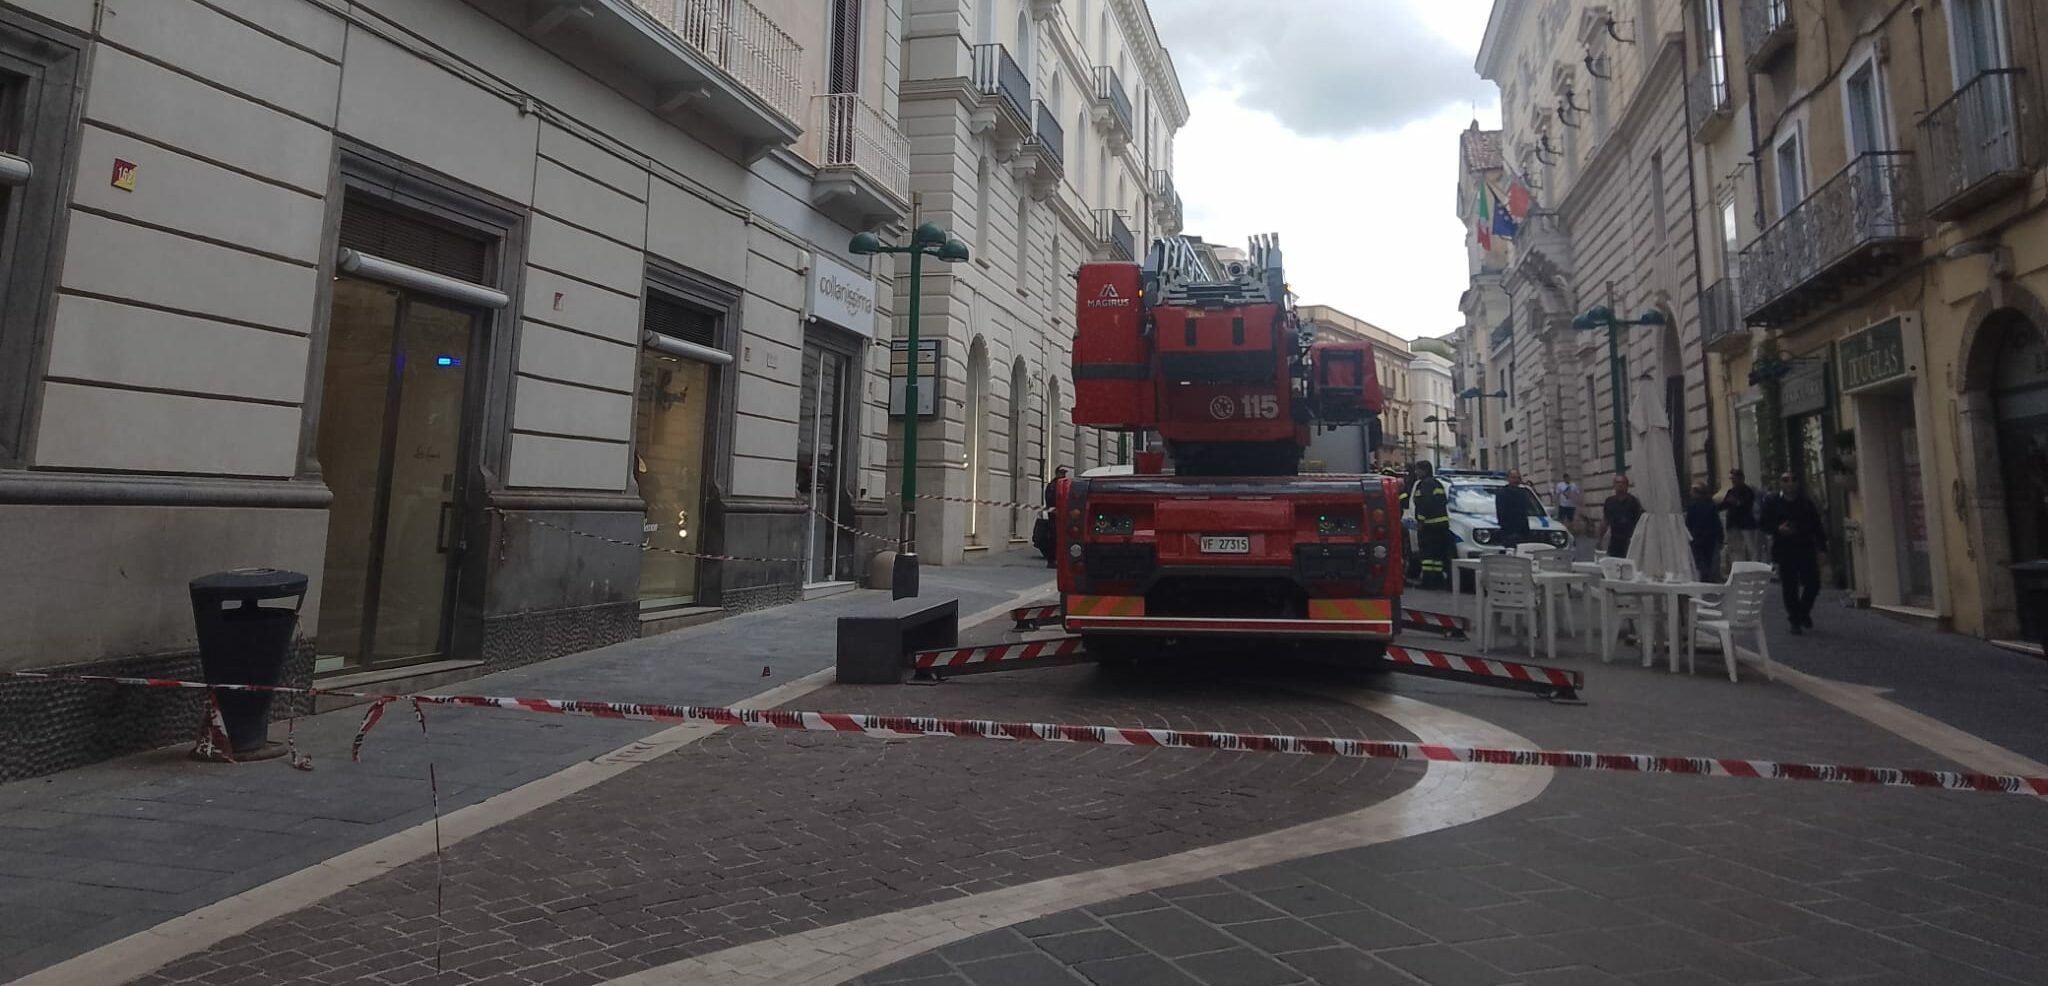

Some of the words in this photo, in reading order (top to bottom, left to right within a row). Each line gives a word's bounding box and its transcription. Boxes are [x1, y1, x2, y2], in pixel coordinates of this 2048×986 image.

[820, 274, 873, 315] collanissima
[1087, 298, 1130, 308] MAGIRUS
[1240, 394, 1279, 419] 115
[1202, 538, 1214, 550] VF
[1219, 538, 1248, 550] 27315
